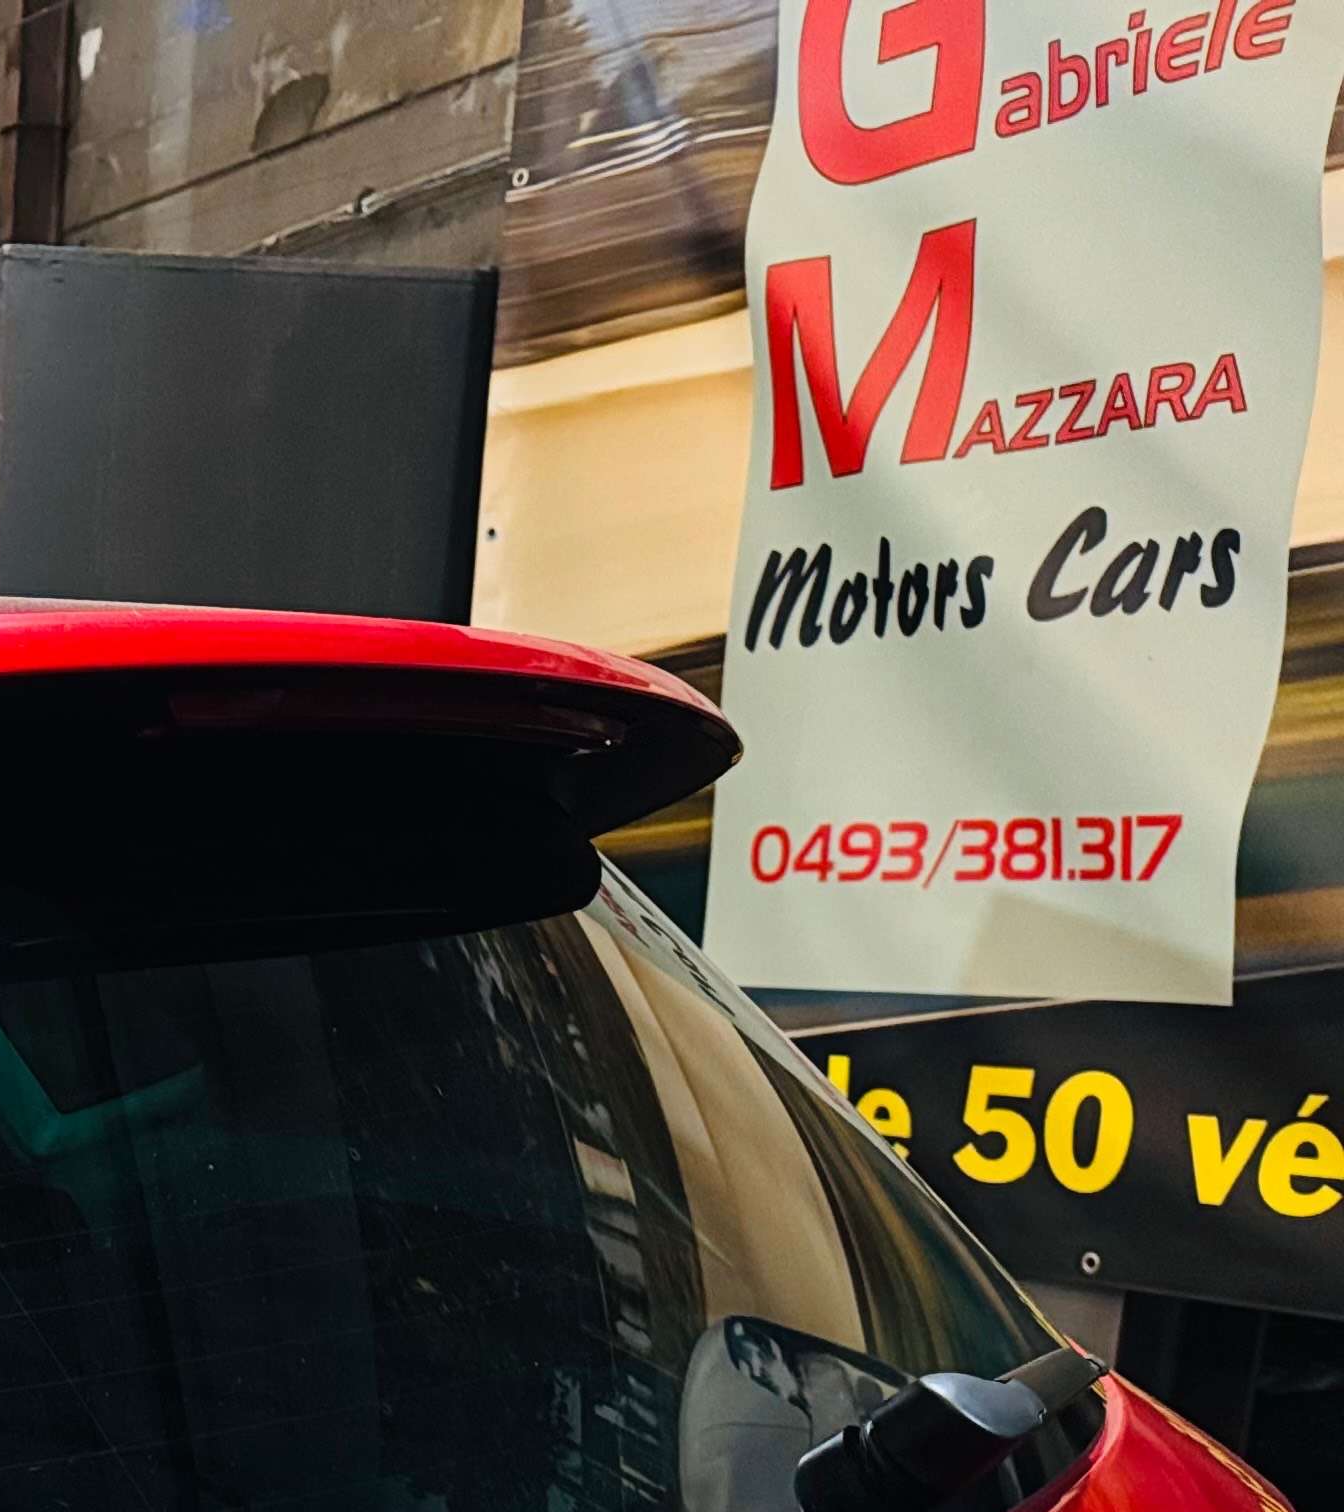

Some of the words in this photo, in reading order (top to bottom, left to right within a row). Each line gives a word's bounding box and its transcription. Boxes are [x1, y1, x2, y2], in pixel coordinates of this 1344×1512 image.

[744, 536, 995, 652] Motors
[1026, 506, 1241, 622] Cars
[750, 814, 1184, 889] 0493/381.317
[953, 1065, 1134, 1194] 50
